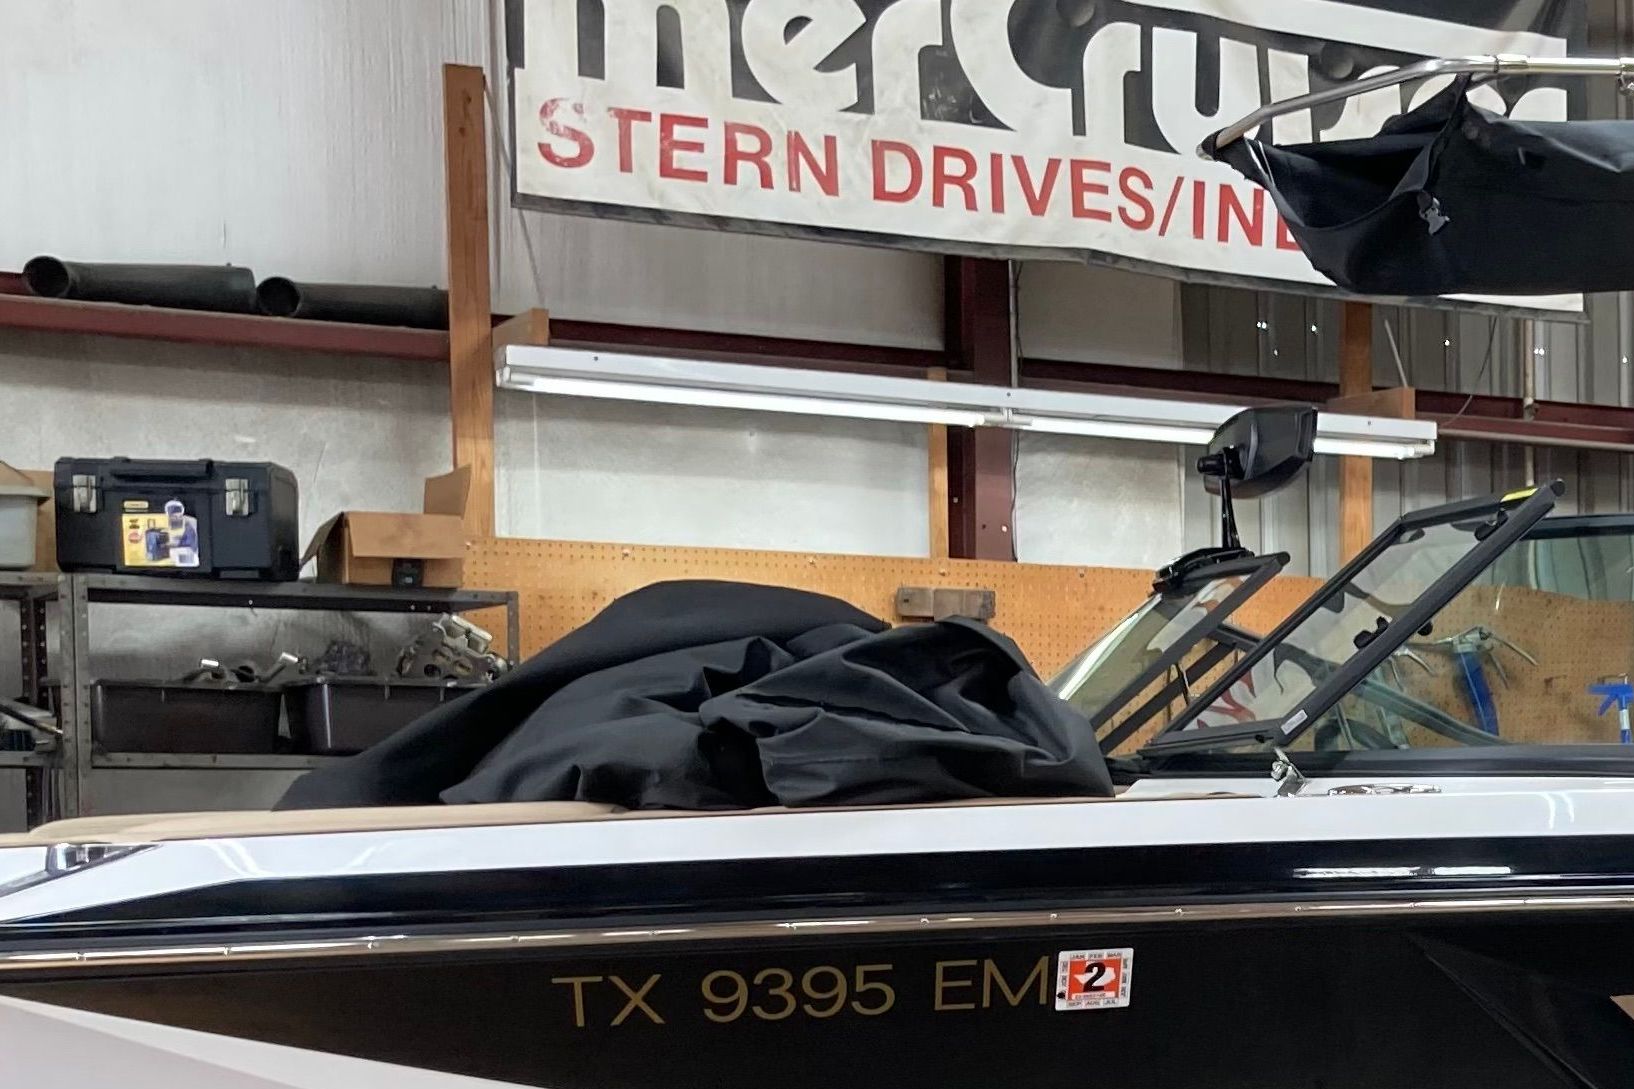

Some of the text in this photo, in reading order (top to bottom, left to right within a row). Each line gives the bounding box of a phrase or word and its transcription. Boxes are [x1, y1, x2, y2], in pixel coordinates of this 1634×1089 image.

[537, 97, 840, 198] STERN
[551, 975, 666, 1028] TX
[701, 964, 897, 1024] 9395
[934, 955, 1049, 1012] EM
[1083, 962, 1106, 993] 2
